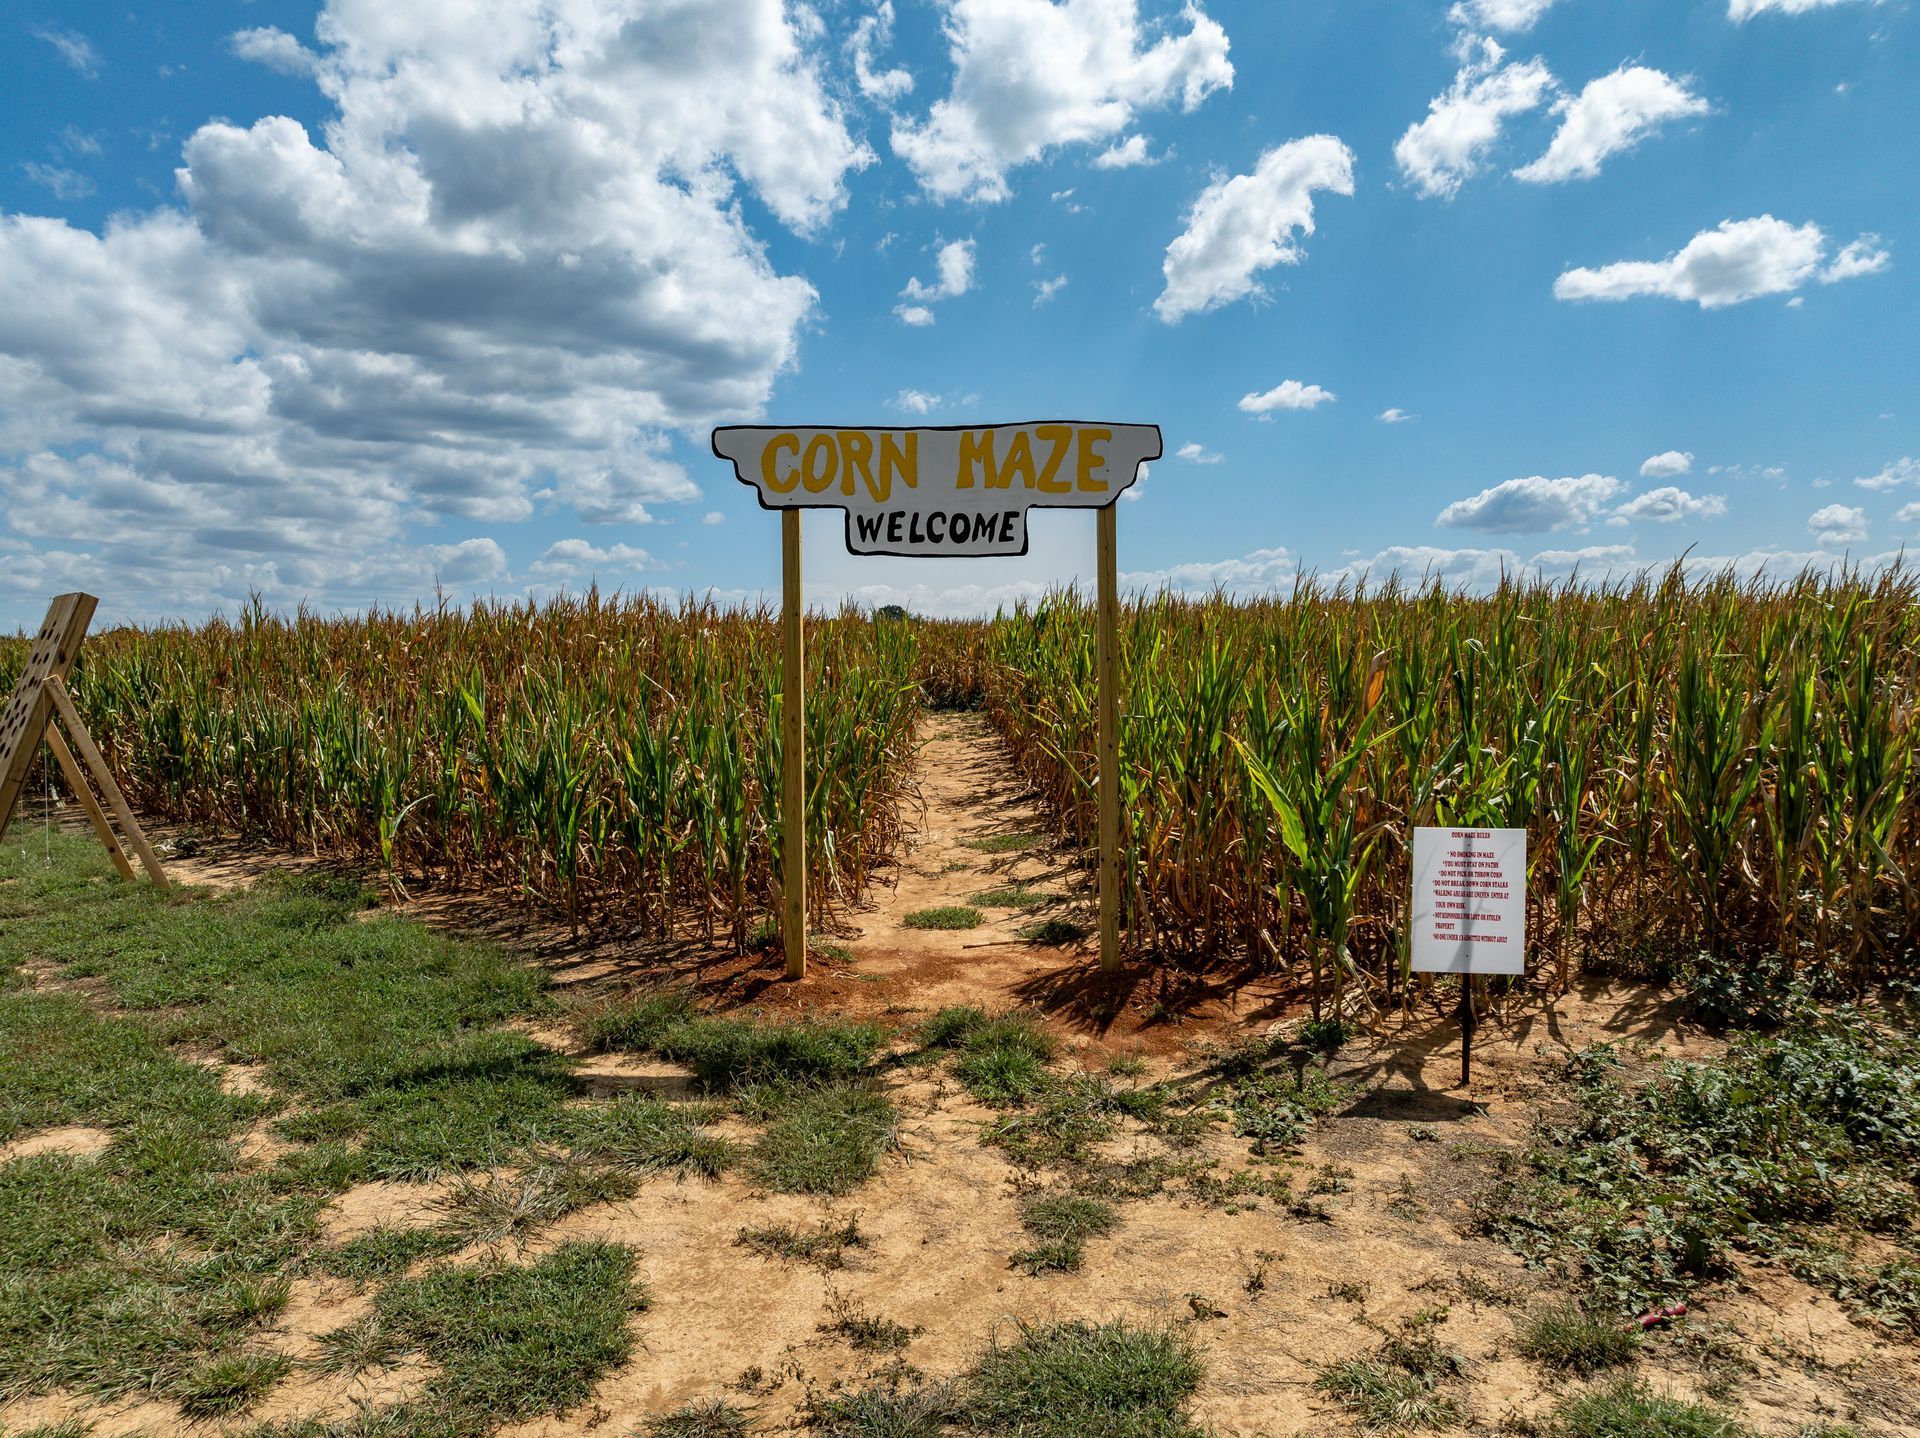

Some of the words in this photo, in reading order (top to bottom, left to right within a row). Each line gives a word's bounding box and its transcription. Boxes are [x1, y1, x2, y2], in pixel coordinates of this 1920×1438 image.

[761, 431, 918, 502] CORN
[956, 425, 1114, 494] MAZE
[857, 511, 1020, 544] WELCOME
